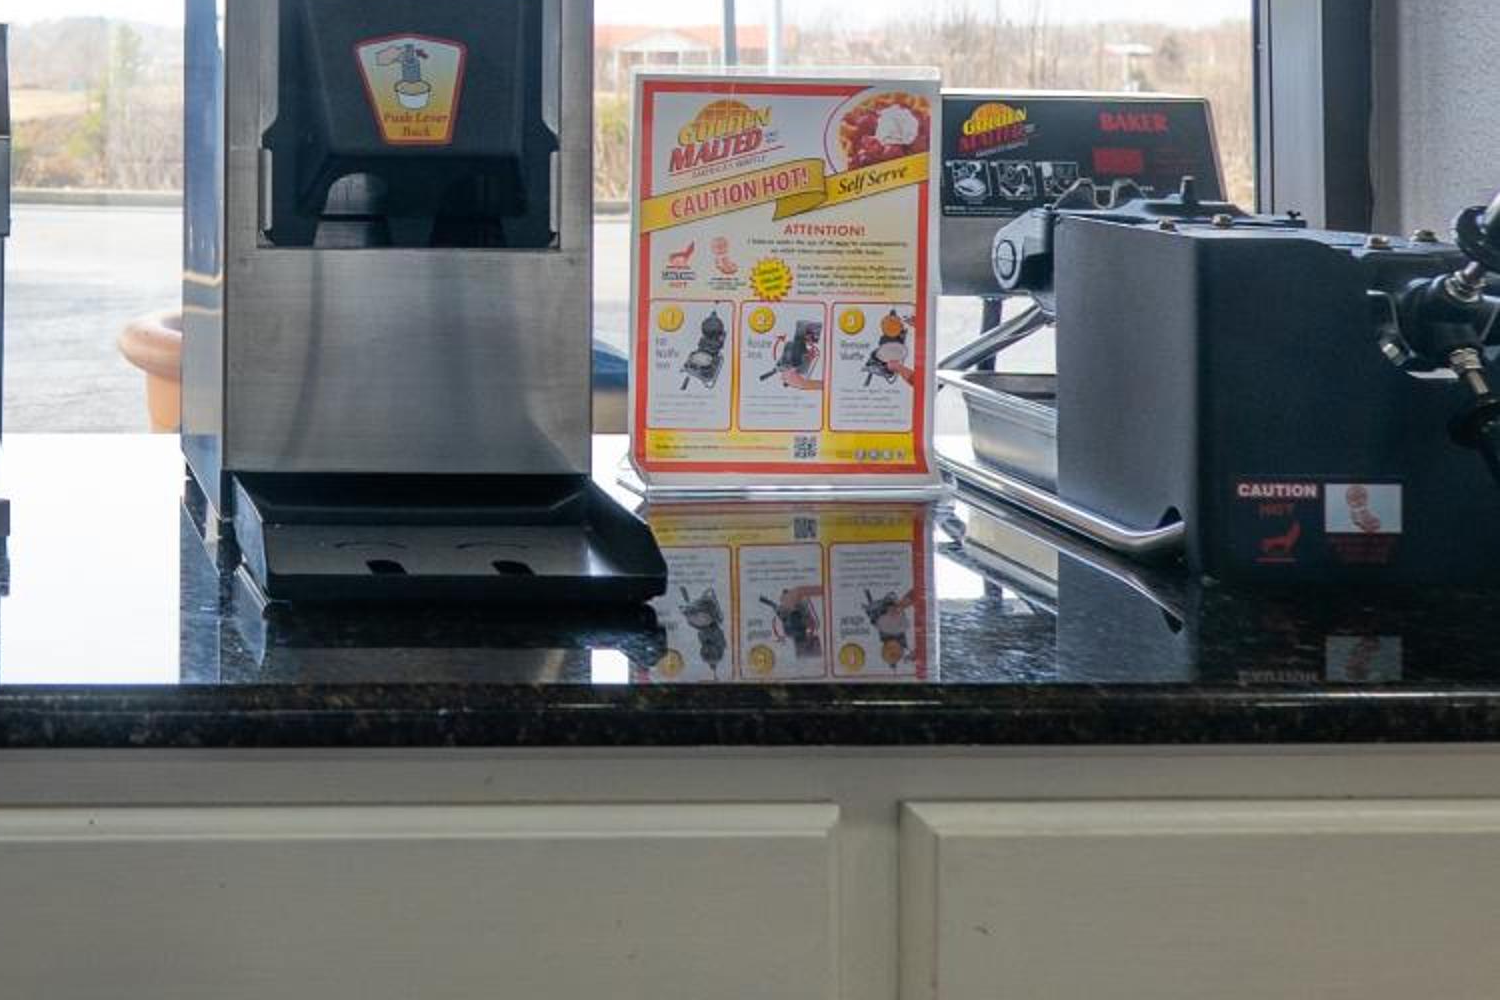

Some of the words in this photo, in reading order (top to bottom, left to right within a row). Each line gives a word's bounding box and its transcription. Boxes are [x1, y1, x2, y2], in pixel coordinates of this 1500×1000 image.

[678, 106, 772, 146] GOLDEN
[1099, 112, 1168, 132] BAKER
[669, 129, 762, 173] MALTED
[671, 182, 756, 218] CAUTION
[763, 167, 809, 191] HOT!
[837, 173, 864, 195] Self
[866, 165, 908, 186] Serve
[784, 224, 866, 236] ATTENTION!
[1237, 484, 1317, 498] CAUTION
